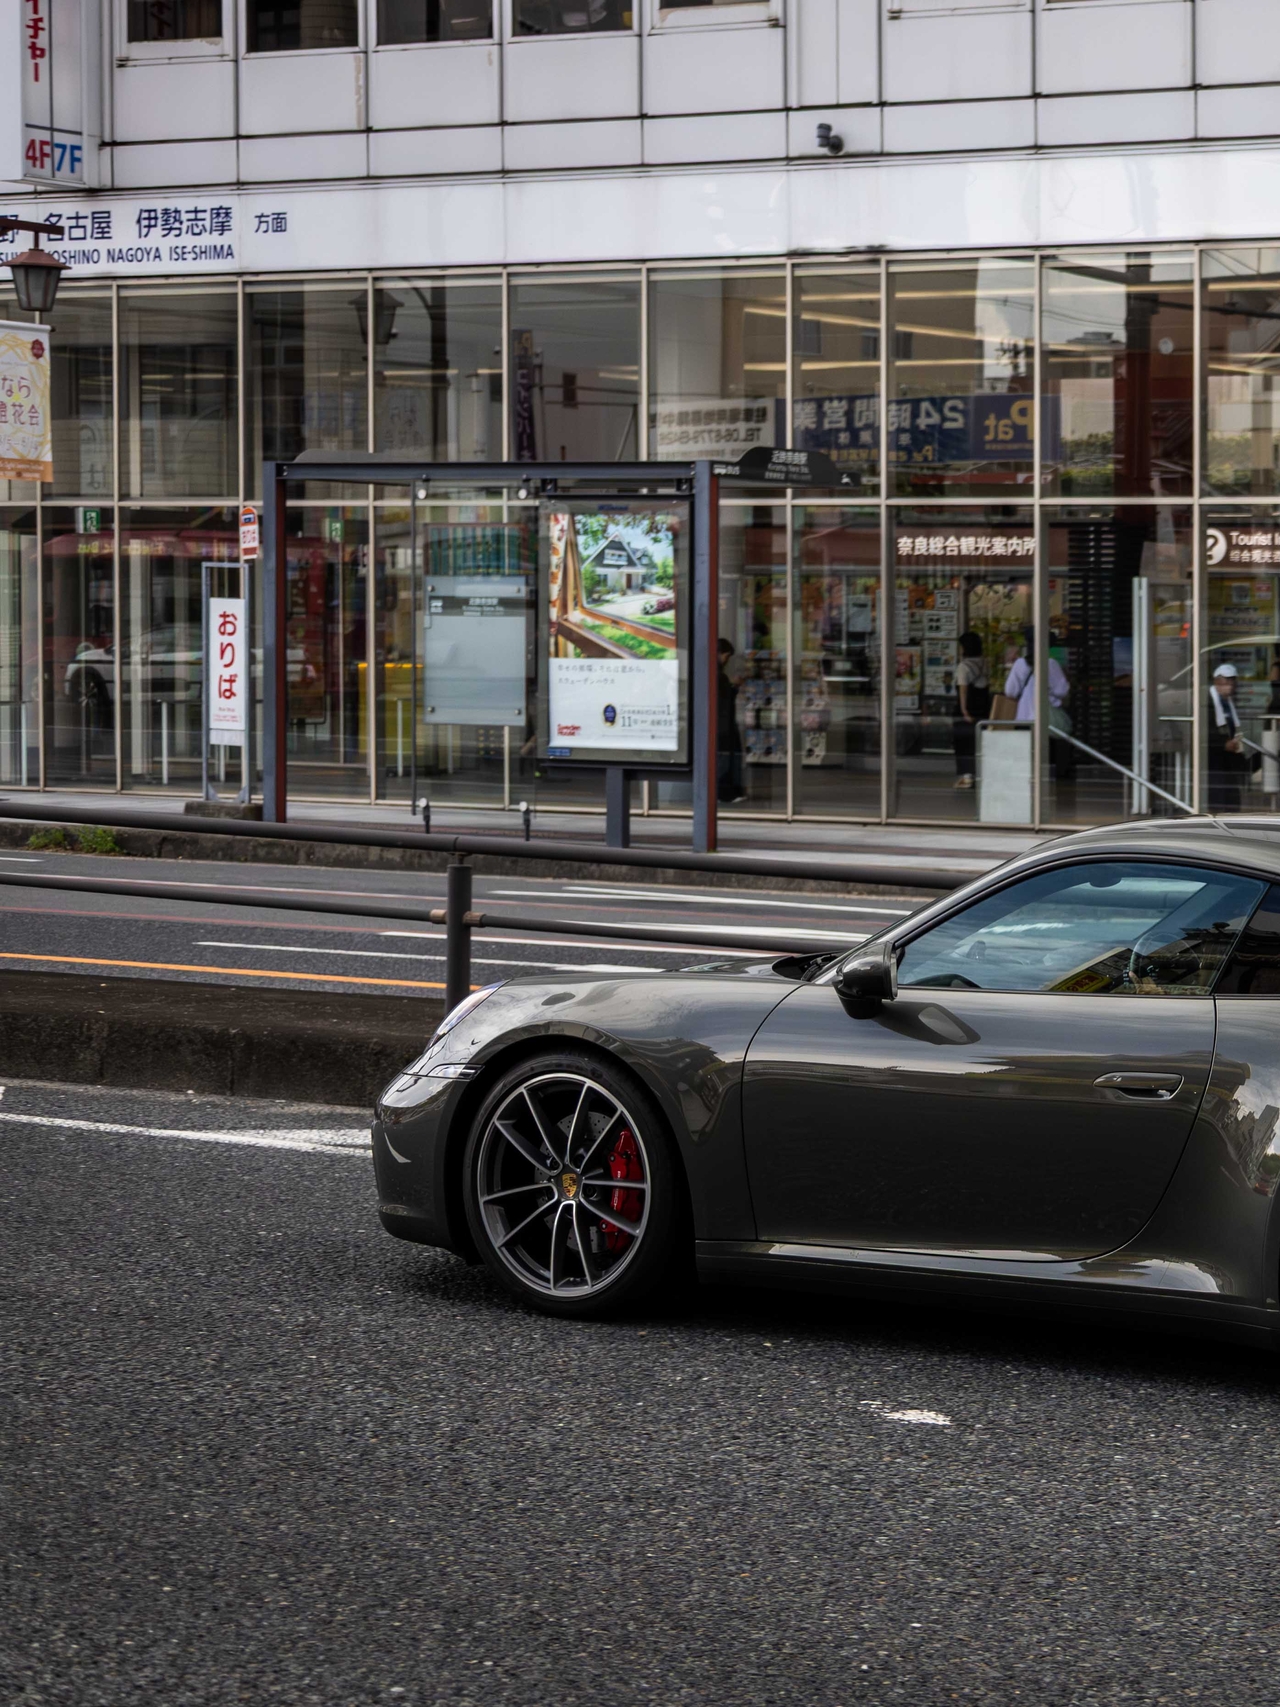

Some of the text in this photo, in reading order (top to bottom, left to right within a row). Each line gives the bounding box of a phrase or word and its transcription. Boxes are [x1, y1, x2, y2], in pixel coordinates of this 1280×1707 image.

[25, 139, 51, 169] 4F
[54, 143, 82, 174] 7F
[136, 205, 233, 239] 伊勢志摩
[254, 212, 288, 233] 方面
[47, 244, 235, 265] OSHINO NAGOYA ISE-SHIMA
[1230, 533, 1272, 546] Tourist
[218, 611, 238, 699] おりば
